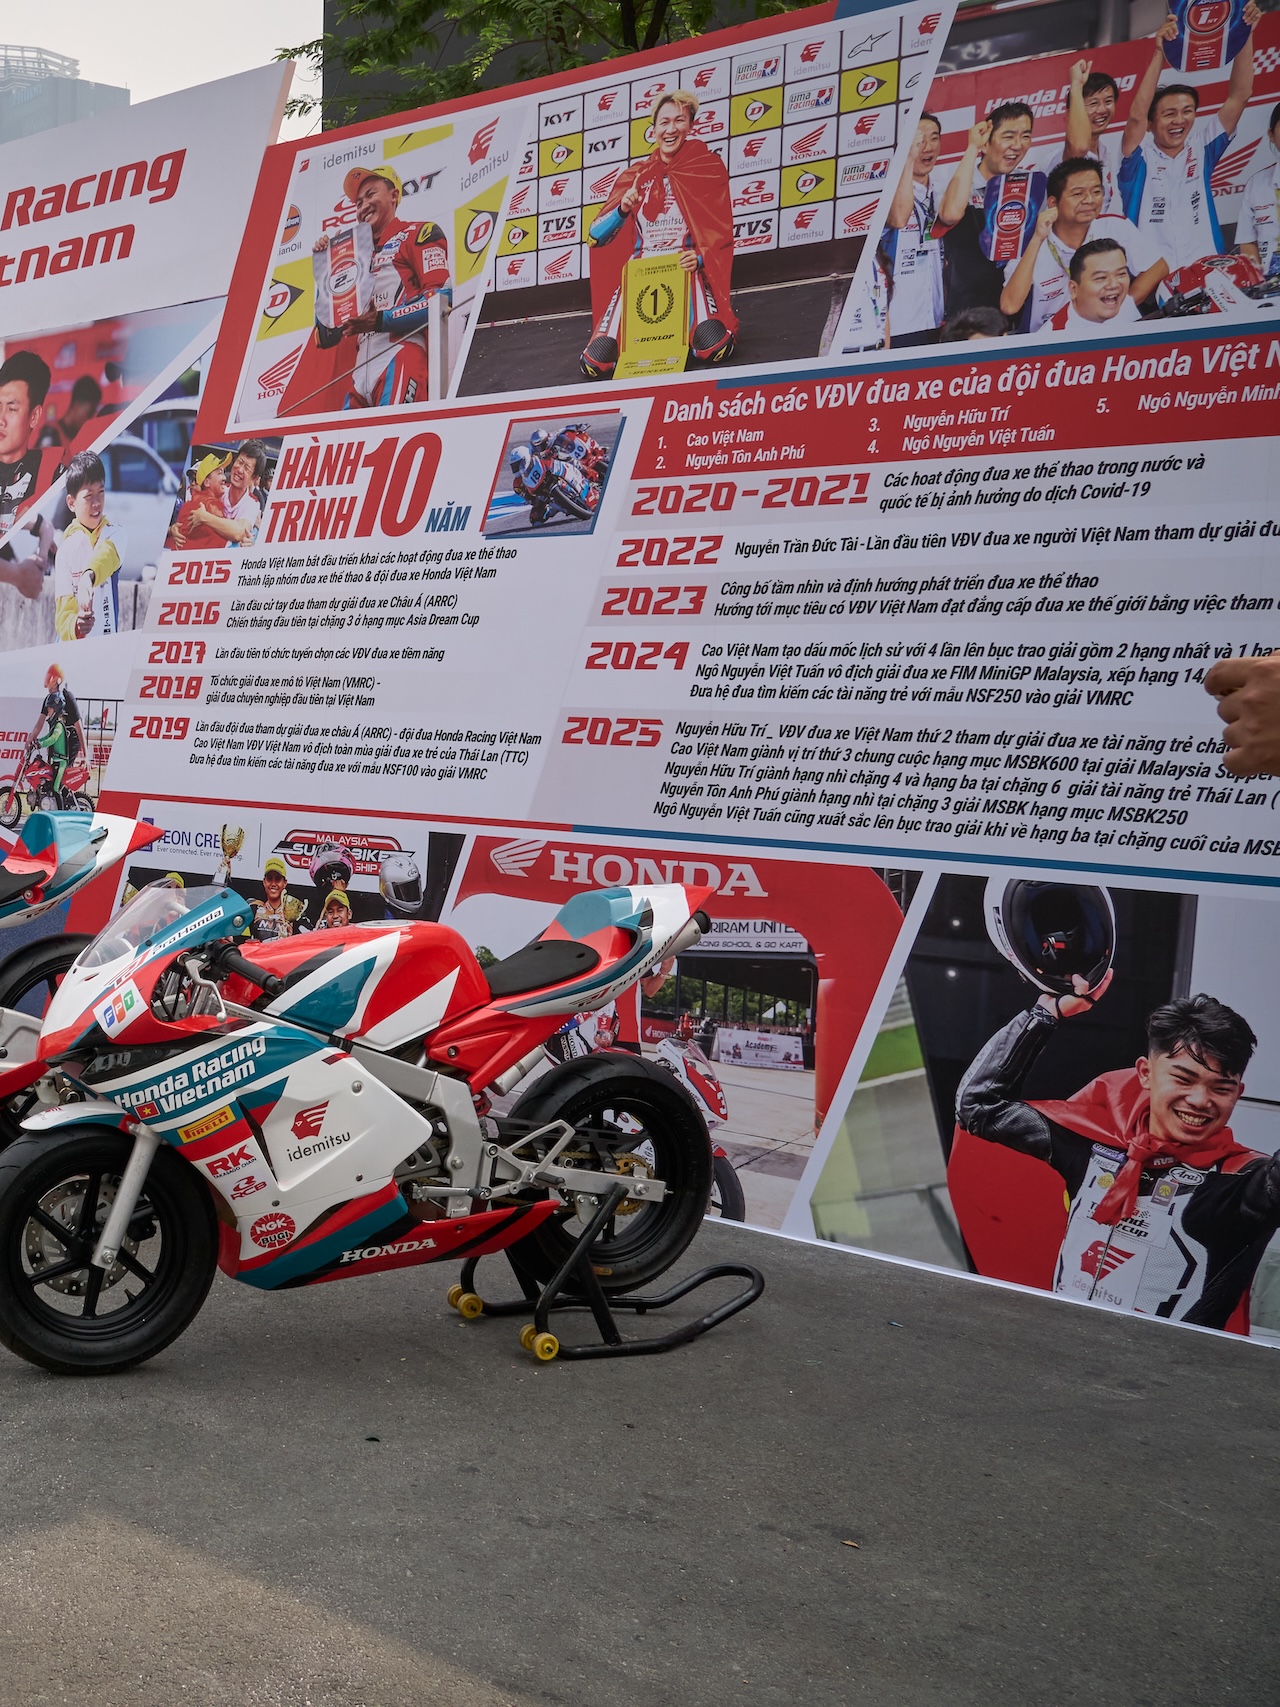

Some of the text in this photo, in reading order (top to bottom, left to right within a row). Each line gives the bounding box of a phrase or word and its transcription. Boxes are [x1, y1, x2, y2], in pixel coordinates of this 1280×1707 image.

[736, 70, 762, 82] racing
[737, 63, 757, 73] uma
[794, 61, 830, 76] idemitsu
[544, 109, 578, 126] KYT
[592, 110, 623, 123] idemitsu
[848, 134, 886, 148] idemitsu
[323, 143, 376, 169] idemitsu
[790, 150, 827, 160] HONDA
[460, 150, 510, 191] idemitsu
[0, 149, 187, 231] Racing
[733, 193, 774, 207] RCB
[543, 215, 576, 232] TVS
[734, 218, 773, 236] TVS
[544, 272, 573, 281] HONDA
[640, 334, 674, 343] DUNLOP
[663, 395, 714, 423] Danh
[718, 390, 766, 418] sách
[770, 386, 808, 413] các
[815, 381, 864, 409] VĐV
[866, 378, 910, 404] đua
[914, 379, 944, 400] xe
[948, 366, 992, 397] của
[998, 362, 1041, 396] đội
[1045, 360, 1096, 388] đua
[1101, 348, 1192, 383] Honda
[1202, 342, 1260, 378] Việt
[1096, 398, 1110, 414] 5.
[1137, 392, 1171, 414] Ngô
[1174, 388, 1238, 410] Nguyễn
[868, 405, 1012, 432] 3. Nguyễn Hữu Trí
[658, 428, 764, 449] 1. Cao Việt Nam
[867, 424, 1055, 454] 4. Ngô Nguyễn Việt Tuấn
[276, 436, 365, 490] HÀNH
[655, 444, 805, 470] 2. Nguyễn Tôn Anh Phú
[884, 472, 909, 488] Các
[944, 468, 981, 486] động
[982, 466, 1010, 482] đua
[1012, 468, 1030, 480] xe
[1033, 460, 1060, 479] thể
[1060, 461, 1094, 477] thao
[1097, 460, 1140, 478] trong
[1140, 454, 1183, 473] nước
[1186, 453, 1206, 470] và
[354, 432, 443, 538] 10
[879, 481, 1151, 514] quốc tế bị ảnh hưởng do dịch Covid-19
[264, 490, 358, 543] TRÌNH
[424, 501, 472, 533] NĂM
[616, 535, 724, 568] 2022
[168, 560, 232, 585] 2015
[601, 585, 708, 616] 2023
[158, 601, 220, 626] 2016
[148, 641, 206, 664] 2017
[585, 641, 691, 670] 2024
[140, 676, 202, 699] 2018
[130, 714, 190, 740] 2019
[561, 716, 664, 748] 2025
[157, 845, 212, 857] Ever connected. Ever
[316, 834, 368, 845] MALAYSIA
[550, 850, 768, 897] HONDA
[104, 989, 136, 1028] FPT
[745, 1040, 773, 1052] Academy
[115, 1036, 266, 1110] Honda Racing
[159, 1061, 256, 1114] Vietnam
[183, 1110, 230, 1139] PIRELLI
[205, 1144, 256, 1175] RK
[287, 1132, 352, 1162] idemitsu
[213, 1157, 257, 1179] TAKASAGO CHAIN
[1176, 1170, 1199, 1182] Arai
[231, 1182, 267, 1200] RCB
[255, 1218, 288, 1233] NGK
[262, 1231, 290, 1245] BUGI
[340, 1238, 437, 1263] HONDA
